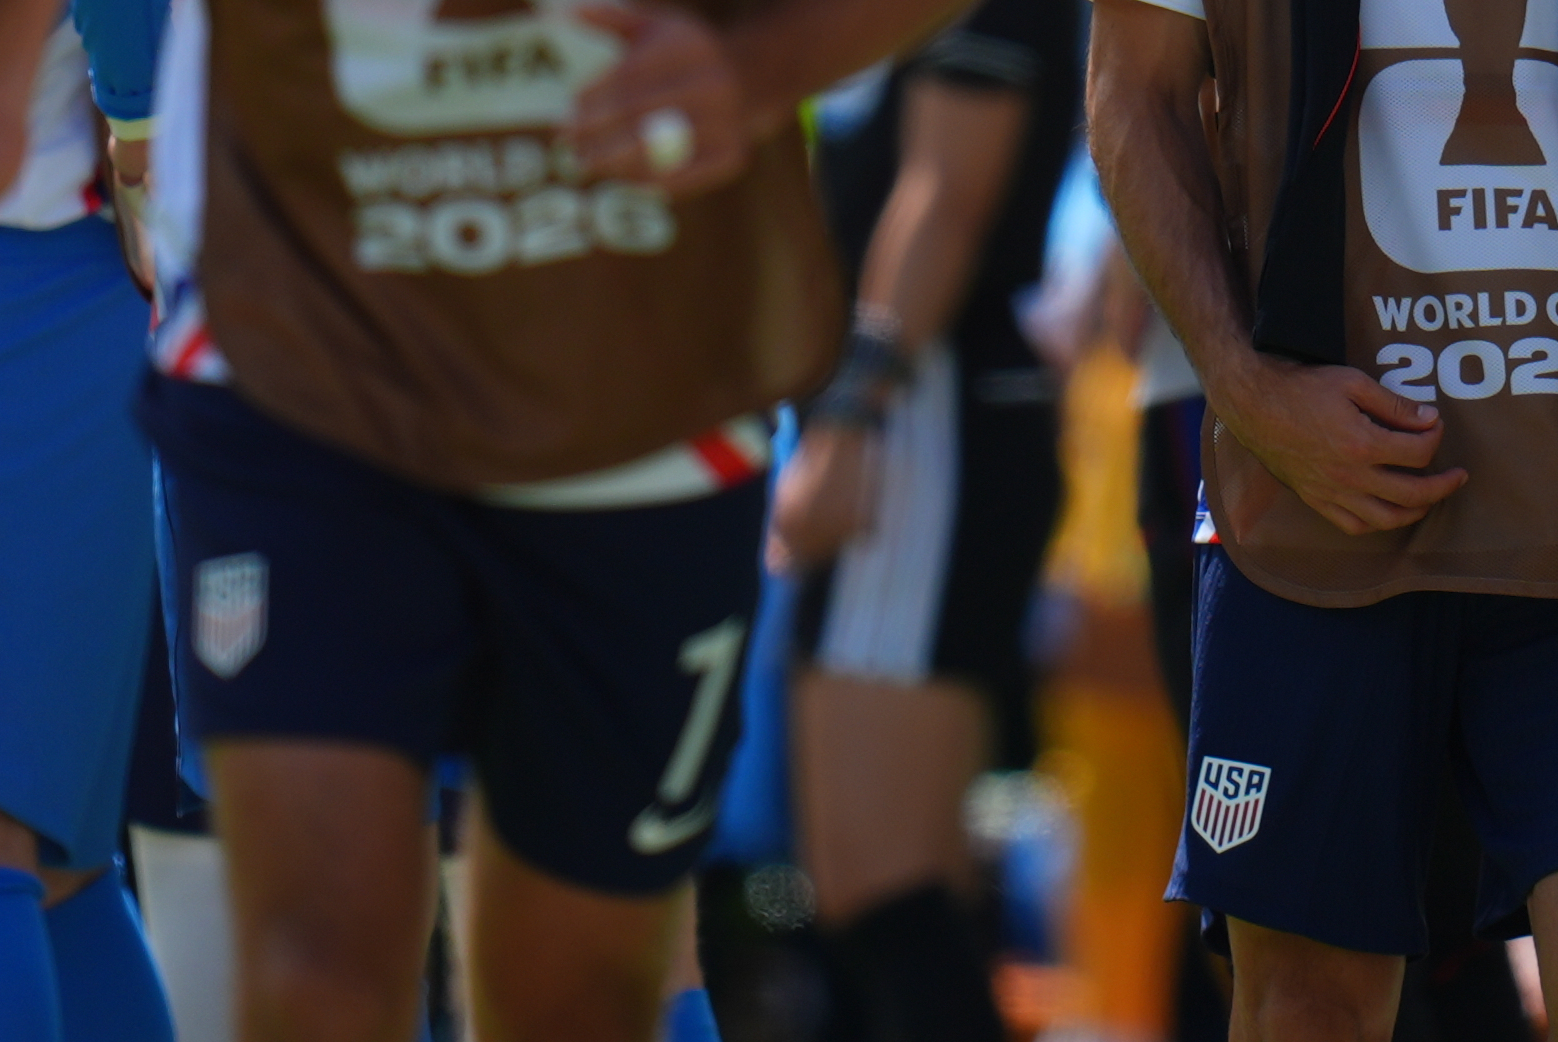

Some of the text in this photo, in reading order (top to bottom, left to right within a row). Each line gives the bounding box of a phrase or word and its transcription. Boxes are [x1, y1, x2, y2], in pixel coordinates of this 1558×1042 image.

[340, 137, 548, 200] WORLD
[350, 182, 676, 276] 2026
[1372, 290, 1538, 332] WORLD
[1203, 761, 1266, 801] USA
